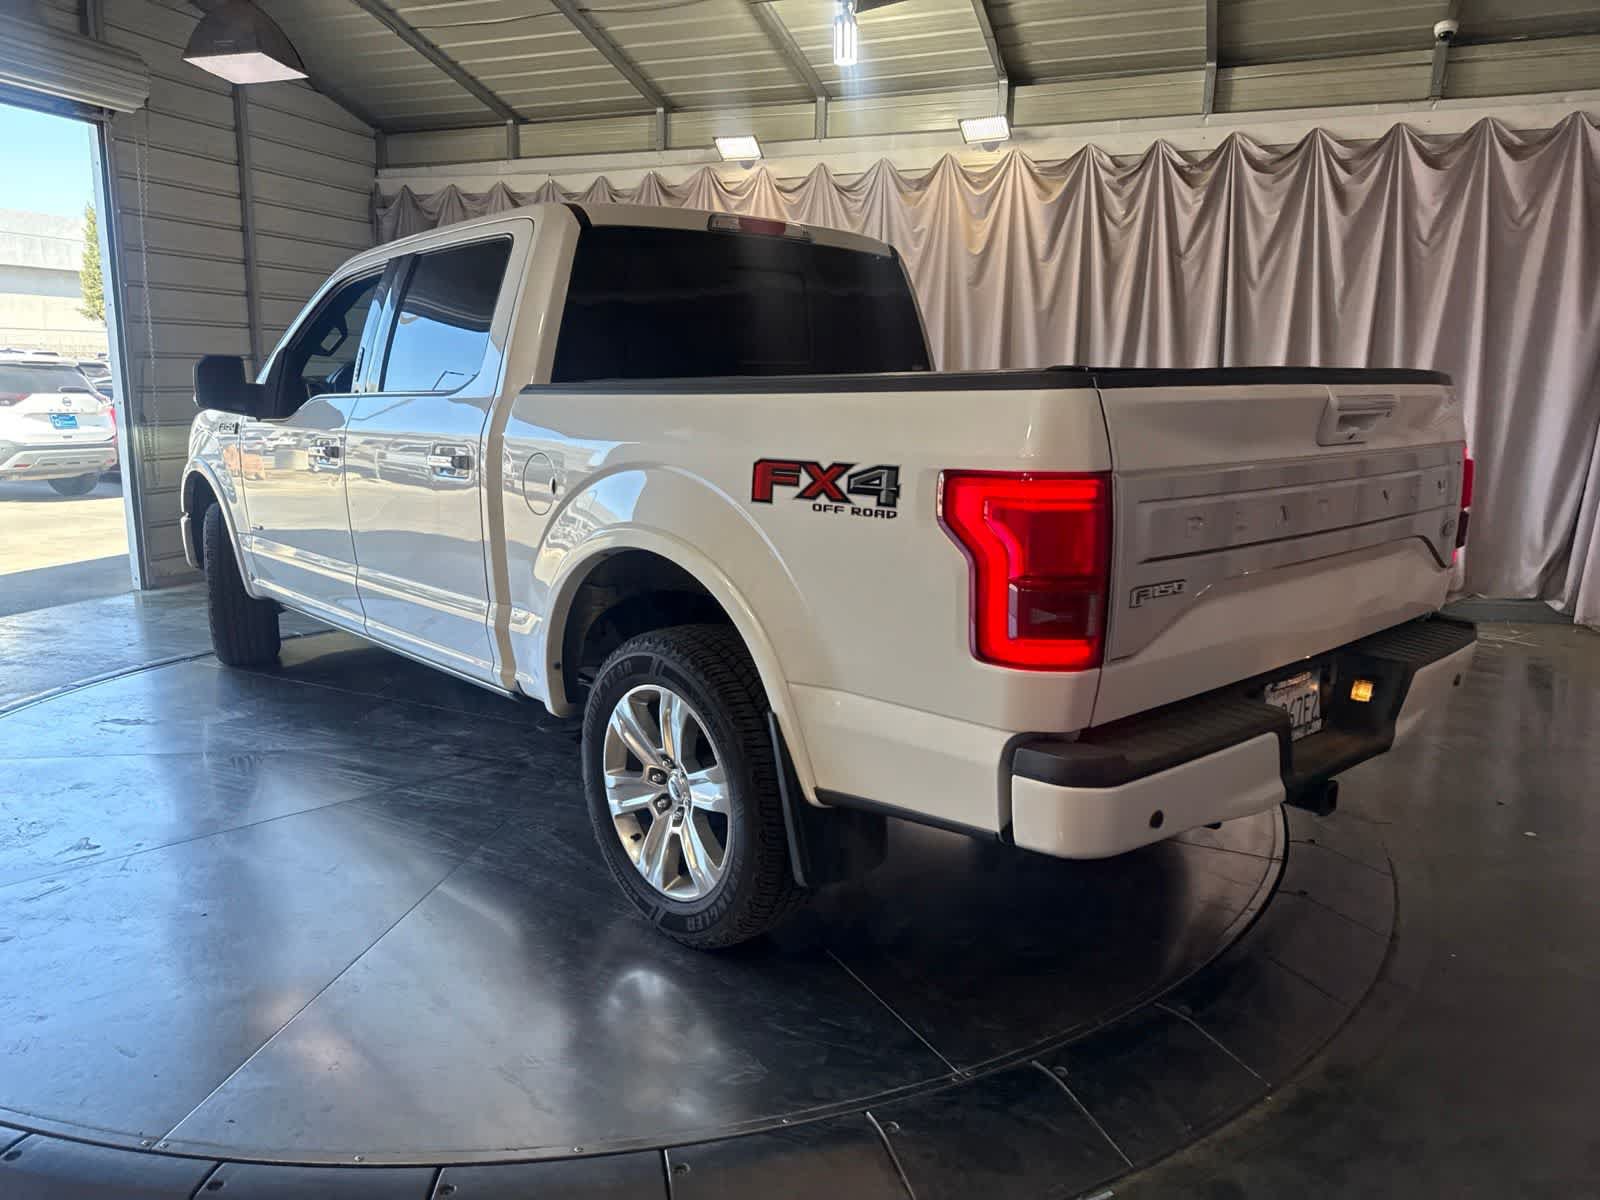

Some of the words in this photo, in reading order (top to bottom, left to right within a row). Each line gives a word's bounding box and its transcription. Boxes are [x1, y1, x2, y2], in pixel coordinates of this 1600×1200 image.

[752, 458, 901, 507] FX4
[812, 503, 844, 514] OFF
[851, 507, 897, 519] ROAD
